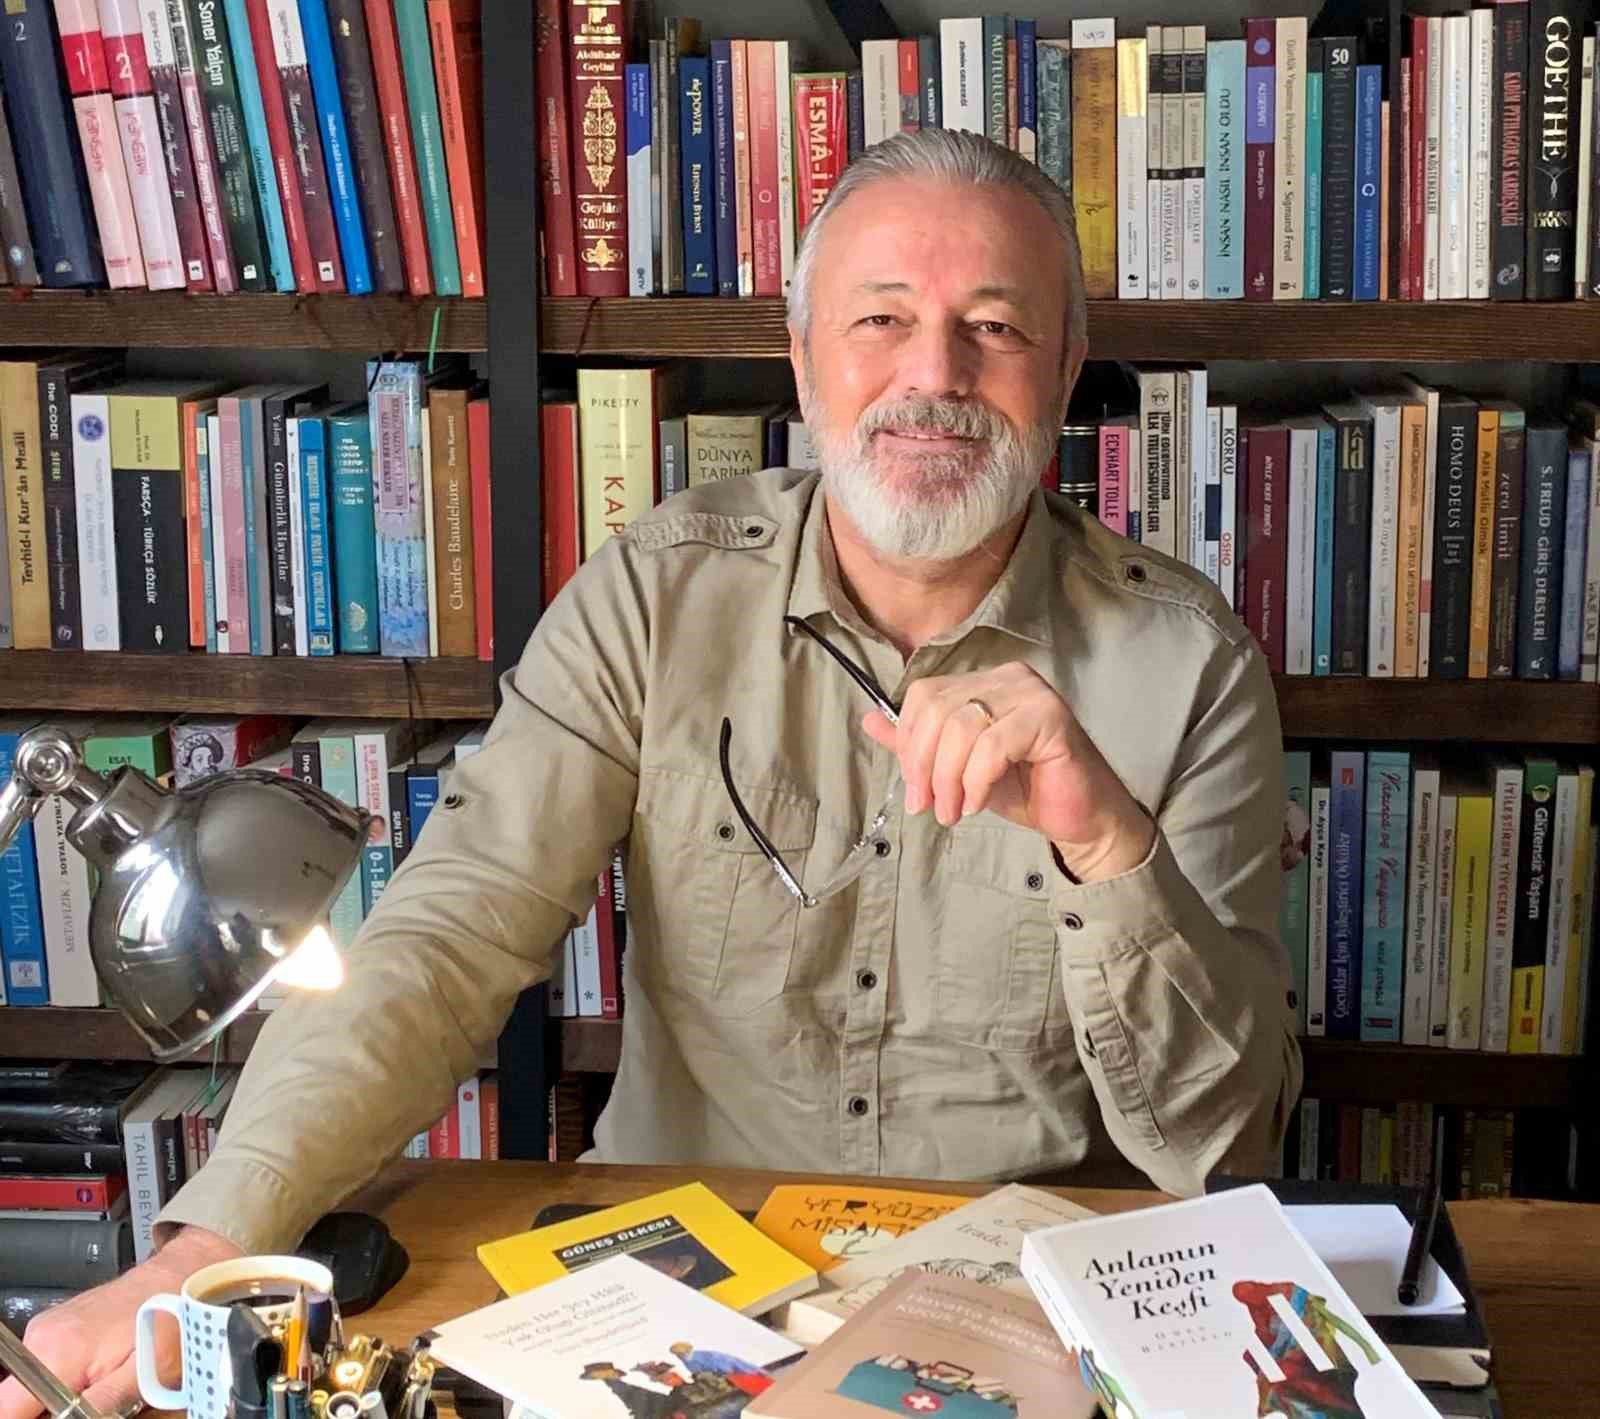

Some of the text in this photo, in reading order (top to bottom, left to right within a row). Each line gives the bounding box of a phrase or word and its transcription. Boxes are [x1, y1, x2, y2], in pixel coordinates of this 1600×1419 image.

[15, 23, 27, 41] 2
[75, 51, 86, 76] 1
[199, 1, 225, 87] Soner Yalçın
[119, 53, 133, 80] 2
[991, 34, 1004, 137] MUTLULUĞUN
[1541, 16, 1572, 162] GOETHE
[808, 96, 832, 180] ESMÂ-İ
[1498, 72, 1526, 227] KADİM PYTHAGORAS KARDEŞLİĞİ
[1217, 89, 1231, 257] İNSAN NASIL İNSAN OLDU
[1282, 191, 1295, 233] Sigmund
[1283, 235, 1295, 262] Freud
[47, 382, 57, 401] the
[48, 404, 59, 441] CODE
[591, 398, 640, 408] PIKETTY
[697, 448, 753, 461] DÜNYA
[1104, 434, 1120, 519] ECKHART TOLLE
[1147, 411, 1161, 533] İLK MUTASAVVIFLAR
[1160, 411, 1172, 501] TÜRK EDEBİYATINDA
[1447, 425, 1465, 528] HOMO DEUS
[273, 461, 287, 527] Günübirlik
[603, 476, 625, 535] KAP
[1222, 428, 1235, 567] KORKU OSHO
[1498, 472, 1518, 560] zero limit
[140, 475, 157, 604] FARSÇA TÜRKÇE SÖZLÜK
[275, 530, 290, 582] Hayatlar
[446, 480, 464, 611] Charles Baudelaire
[1532, 465, 1552, 641] S. FREUD GİRİŞ DERSLERİ
[302, 754, 312, 772] the
[57, 842, 69, 876] SOSYAL
[392, 811, 404, 849] SUN TZU
[1495, 781, 1519, 938] İYİLEŞTİREN YİYECEKLER
[1526, 807, 1549, 920] Glutensiz Yaşam
[59, 889, 75, 954] METAFİZİK
[132, 1133, 149, 1184] TAHIL
[1084, 1242, 1217, 1279] Anlamın
[1095, 1266, 1217, 1300] Yeniden
[1129, 1287, 1211, 1320] Keşfi
